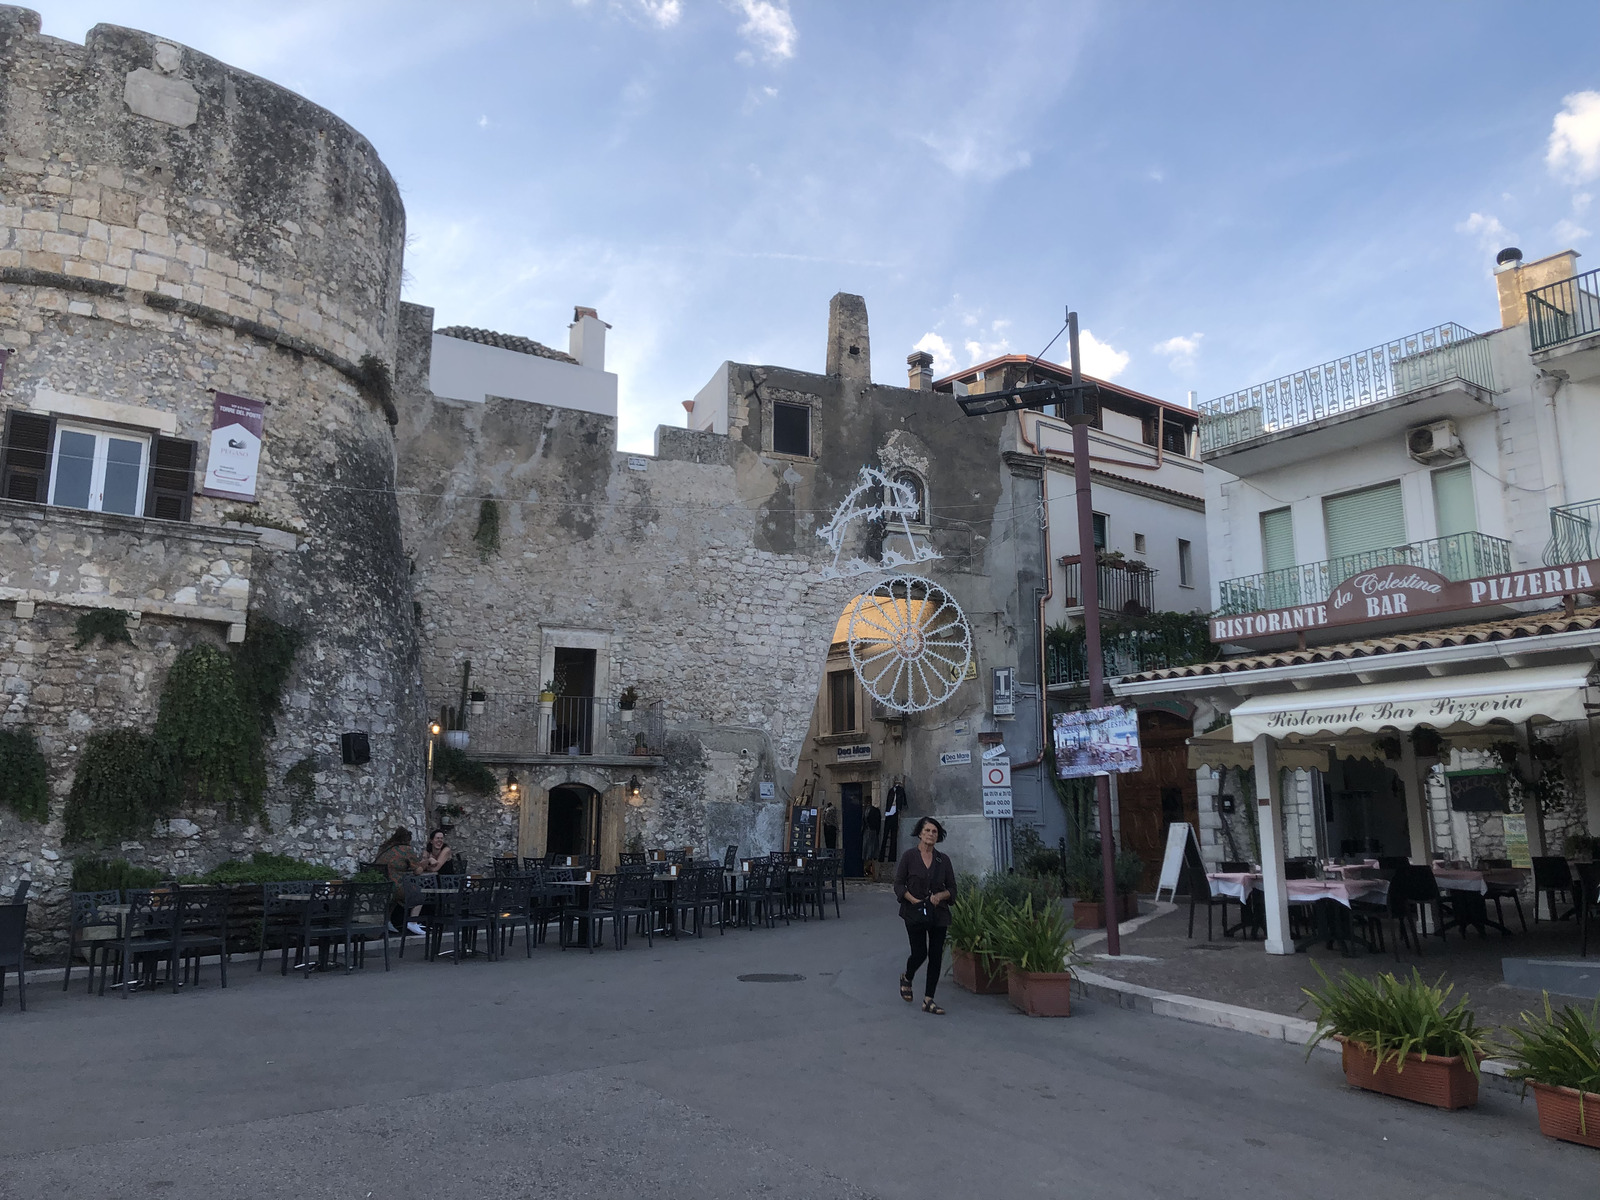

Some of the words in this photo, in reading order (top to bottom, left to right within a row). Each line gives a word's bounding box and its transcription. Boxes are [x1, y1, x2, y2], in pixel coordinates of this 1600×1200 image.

[236, 409, 246, 417] DEL
[1334, 589, 1354, 610] da
[1354, 572, 1442, 596] Celestina
[1469, 565, 1594, 604] PIZZERIA
[1215, 604, 1328, 639] RISTORANTE
[1366, 593, 1409, 618] BAR
[1267, 706, 1365, 728] Ristorante
[1371, 702, 1416, 720] Bar
[1429, 695, 1528, 721] Pizzeria
